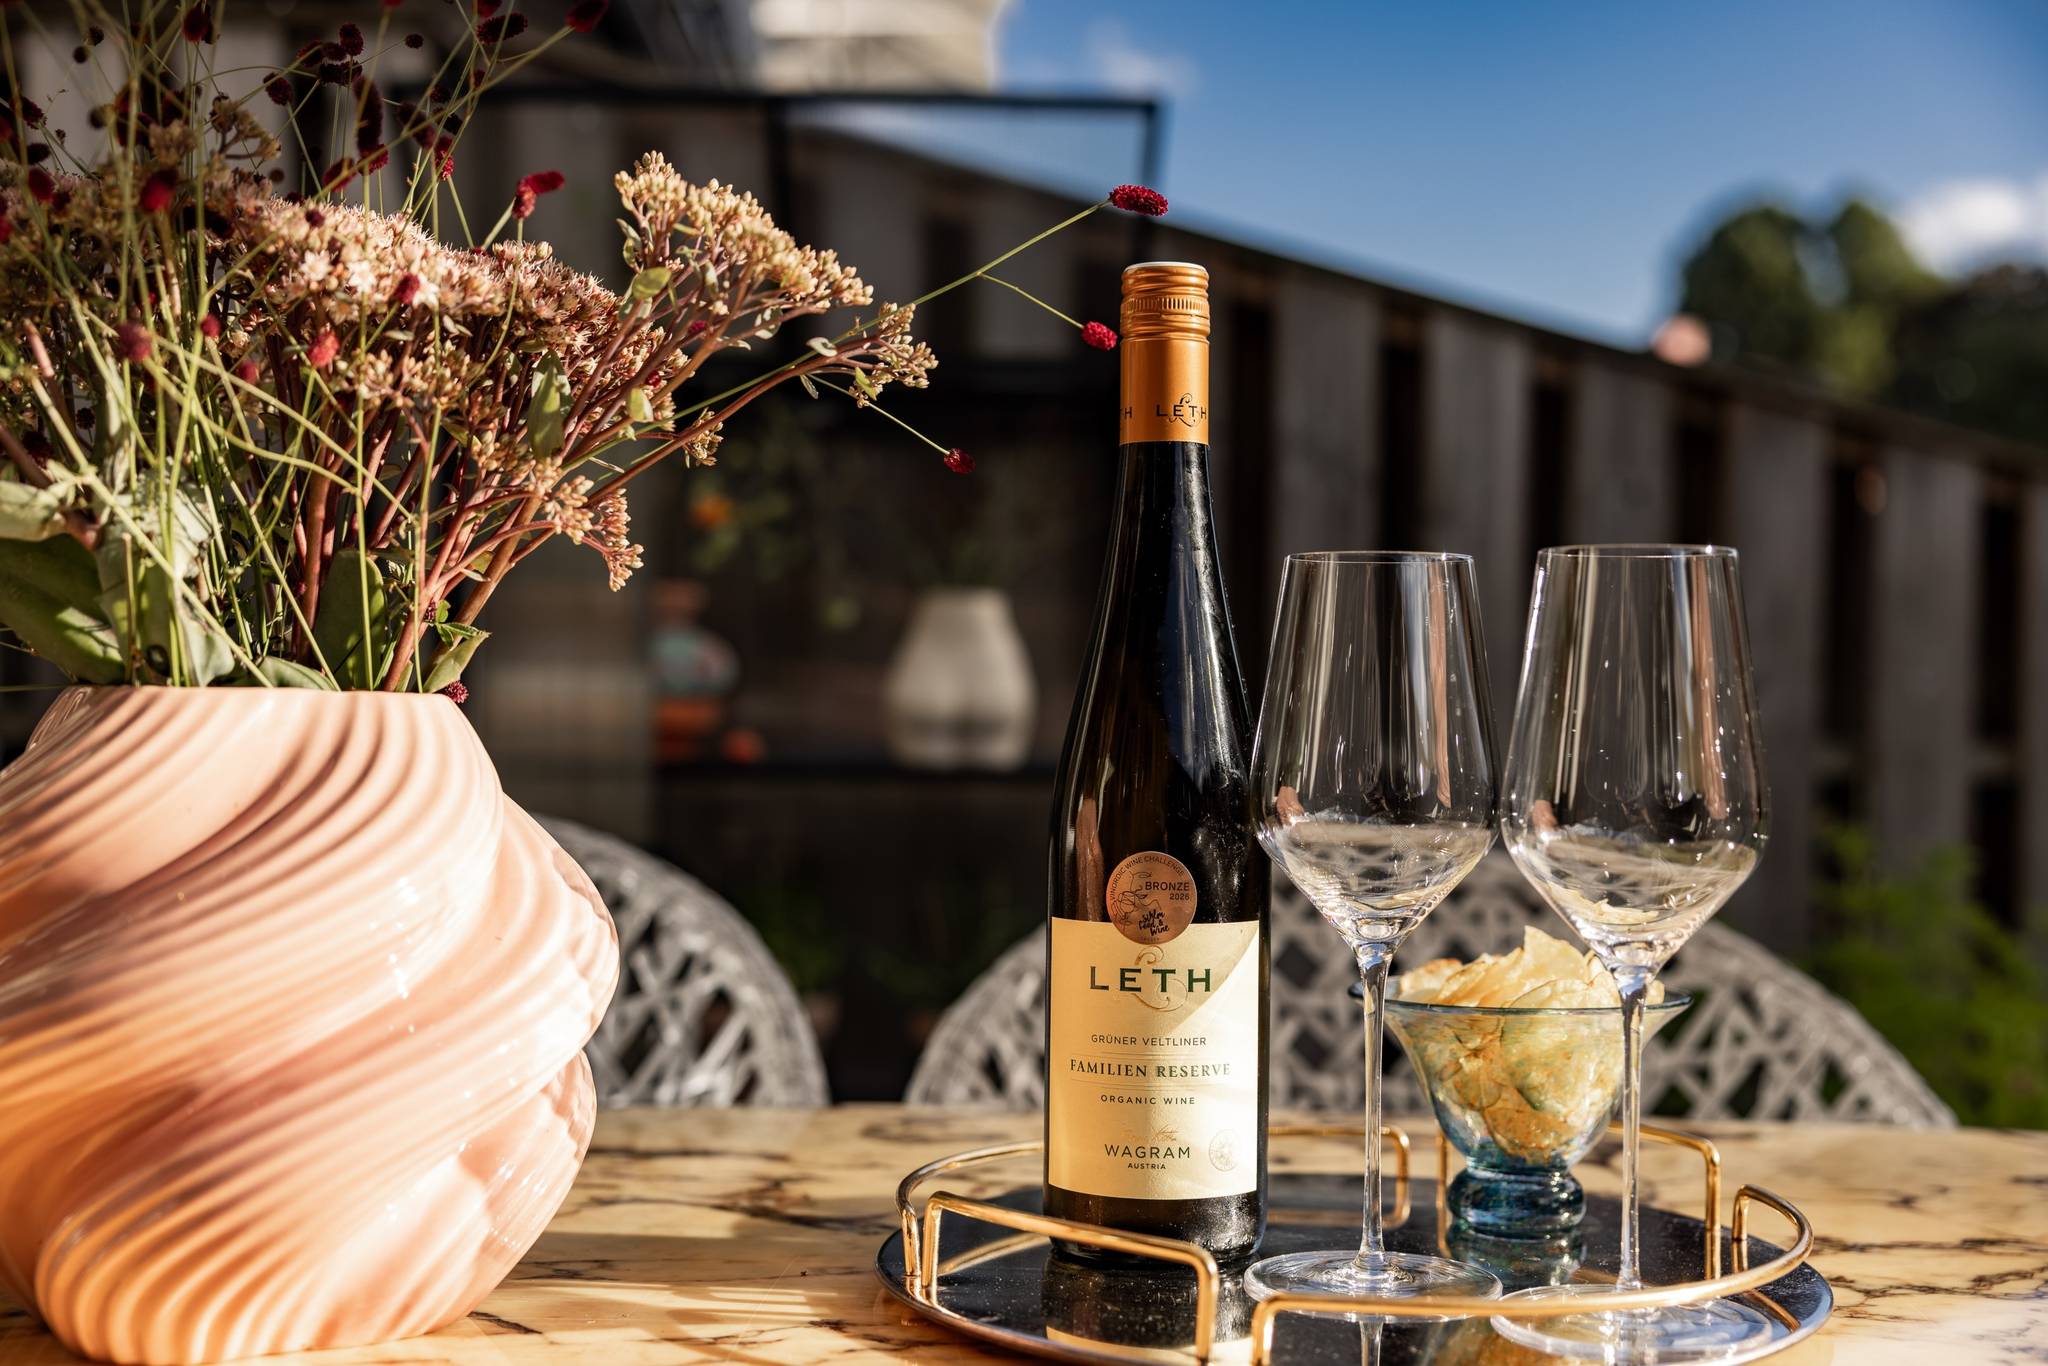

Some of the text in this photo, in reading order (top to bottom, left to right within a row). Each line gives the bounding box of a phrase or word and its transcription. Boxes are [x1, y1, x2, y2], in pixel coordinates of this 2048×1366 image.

[1156, 404, 1207, 420] LETH
[1125, 856, 1143, 870] WINE
[1143, 855, 1184, 876] CHALLENGE
[1145, 881, 1190, 891] BRONZE
[1150, 925, 1169, 936] Wine
[1090, 965, 1211, 993] LETH
[1091, 1034, 1207, 1047] GRÜNER VELTLINER
[1070, 1058, 1231, 1079] FAMILIEN RESERVE
[1100, 1094, 1196, 1105] ORGANIC WINE
[1104, 1143, 1191, 1159] WAGRAM
[1127, 1162, 1167, 1170] AUSTRIA
